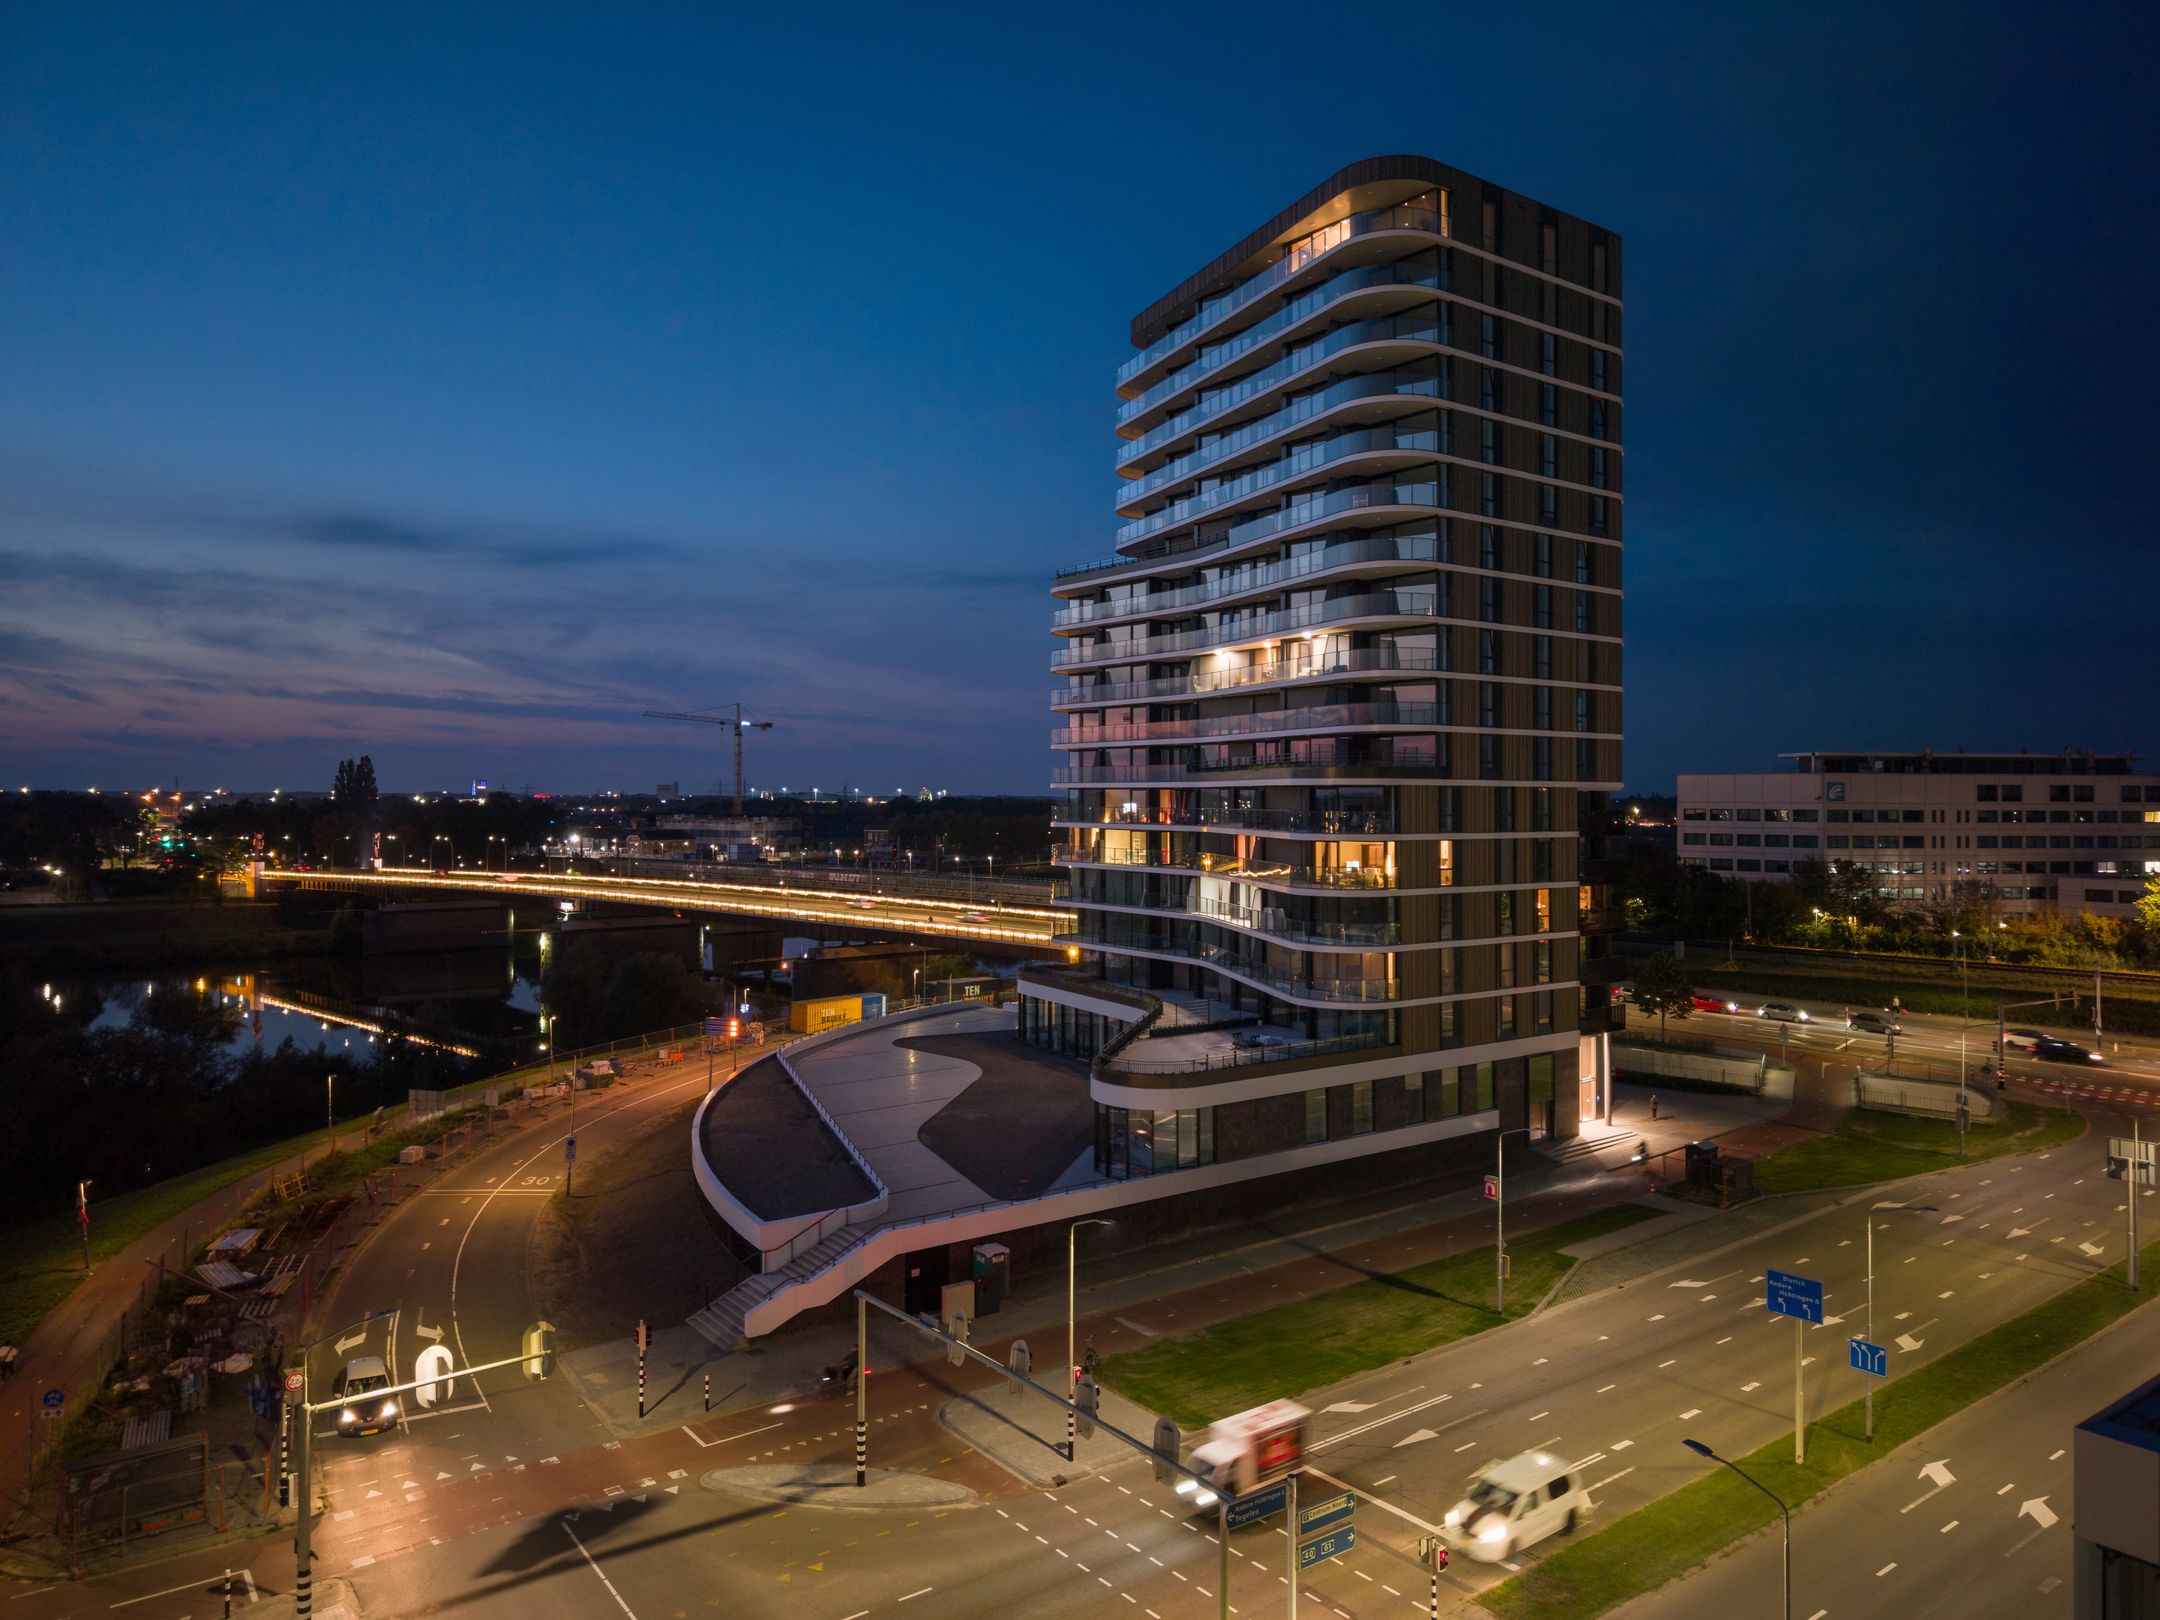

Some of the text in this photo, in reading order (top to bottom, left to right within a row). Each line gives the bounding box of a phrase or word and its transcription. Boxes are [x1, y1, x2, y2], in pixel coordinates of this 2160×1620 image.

[964, 984, 980, 996] TEN
[521, 1176, 550, 1185] 30
[1769, 1280, 1792, 1290] Andere
[1780, 1290, 1813, 1303] richtingen
[1309, 1499, 1347, 1518] Centrum-Noord
[1304, 1543, 1332, 1559] 40 61
